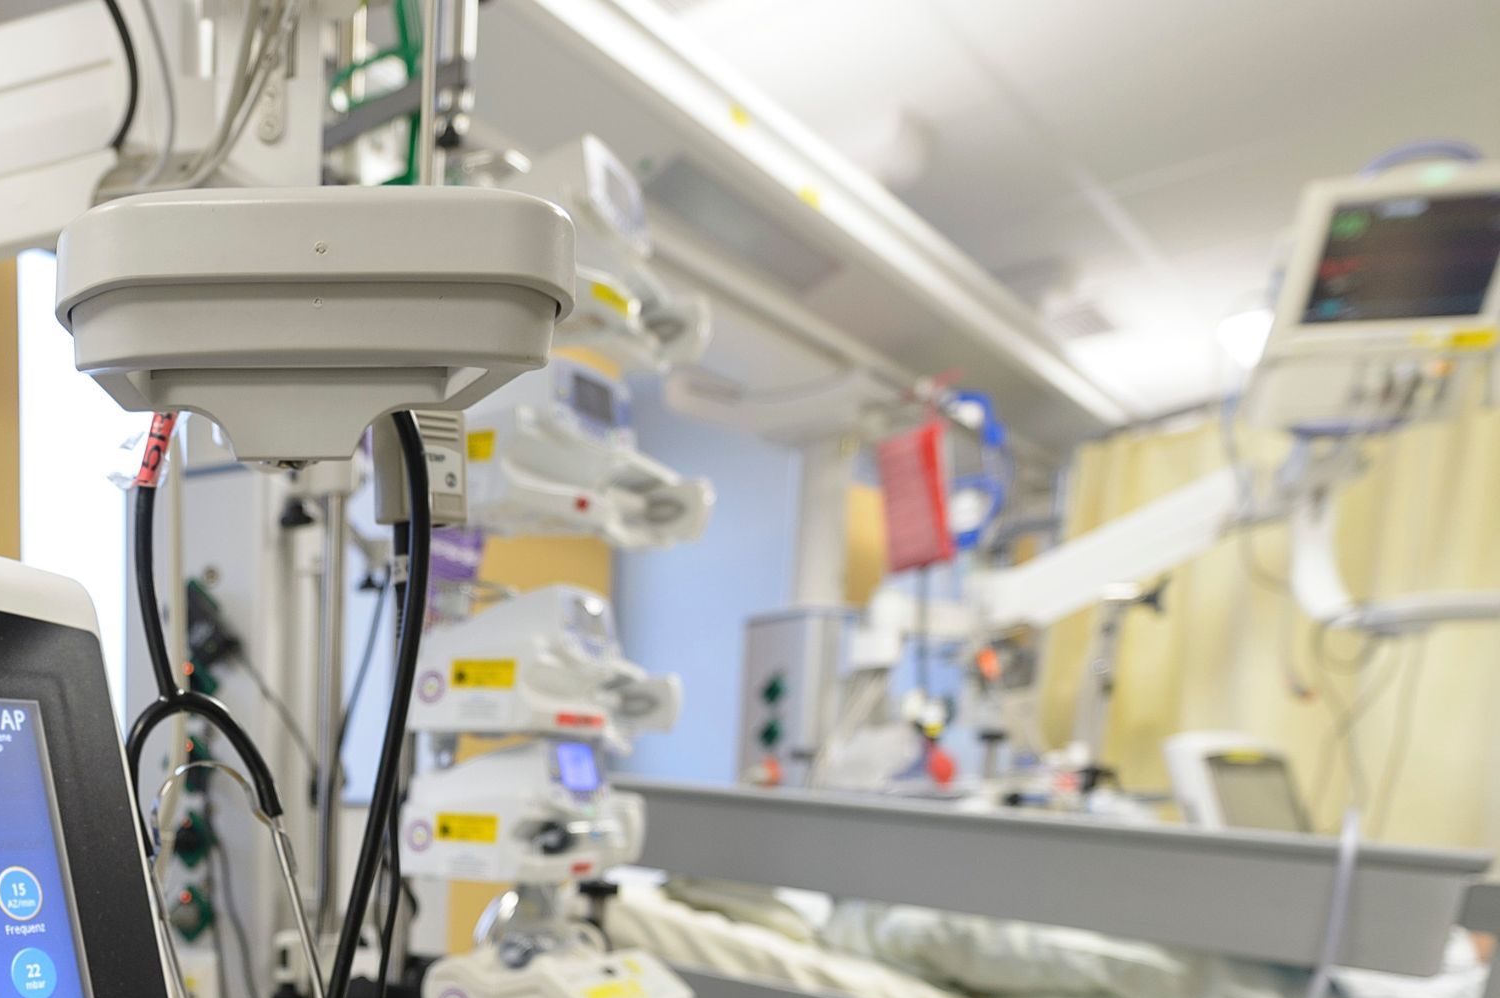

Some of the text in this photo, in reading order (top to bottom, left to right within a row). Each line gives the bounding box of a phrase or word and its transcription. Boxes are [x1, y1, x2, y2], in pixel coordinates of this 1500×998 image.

[12, 883, 26, 896] 15
[5, 923, 46, 936] Frequenz
[26, 964, 41, 978] 22
[26, 978, 46, 990] mbar
